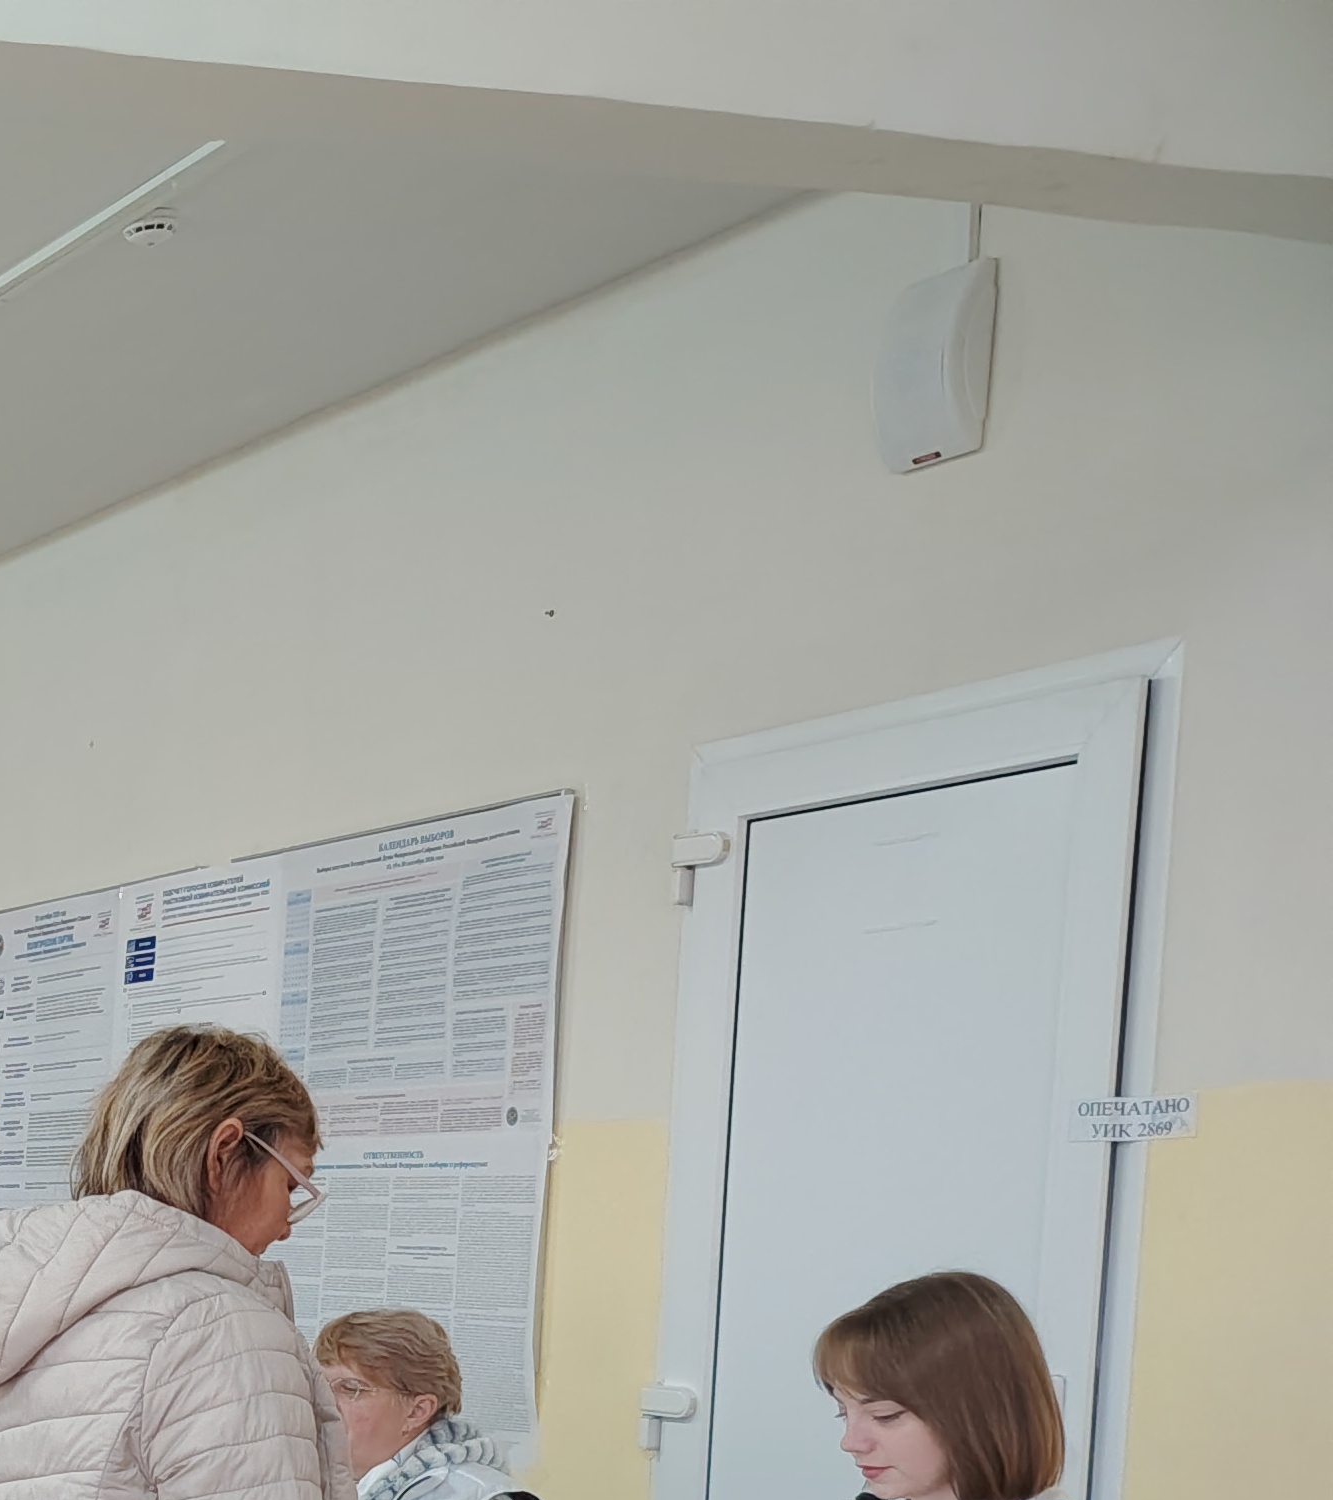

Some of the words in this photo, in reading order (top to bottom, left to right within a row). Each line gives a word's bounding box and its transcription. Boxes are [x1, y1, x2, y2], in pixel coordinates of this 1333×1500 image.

[1077, 1097, 1191, 1117] ОПЕЧАТАНО
[1091, 1122, 1133, 1139] УИК
[1137, 1120, 1174, 1138] 2869
